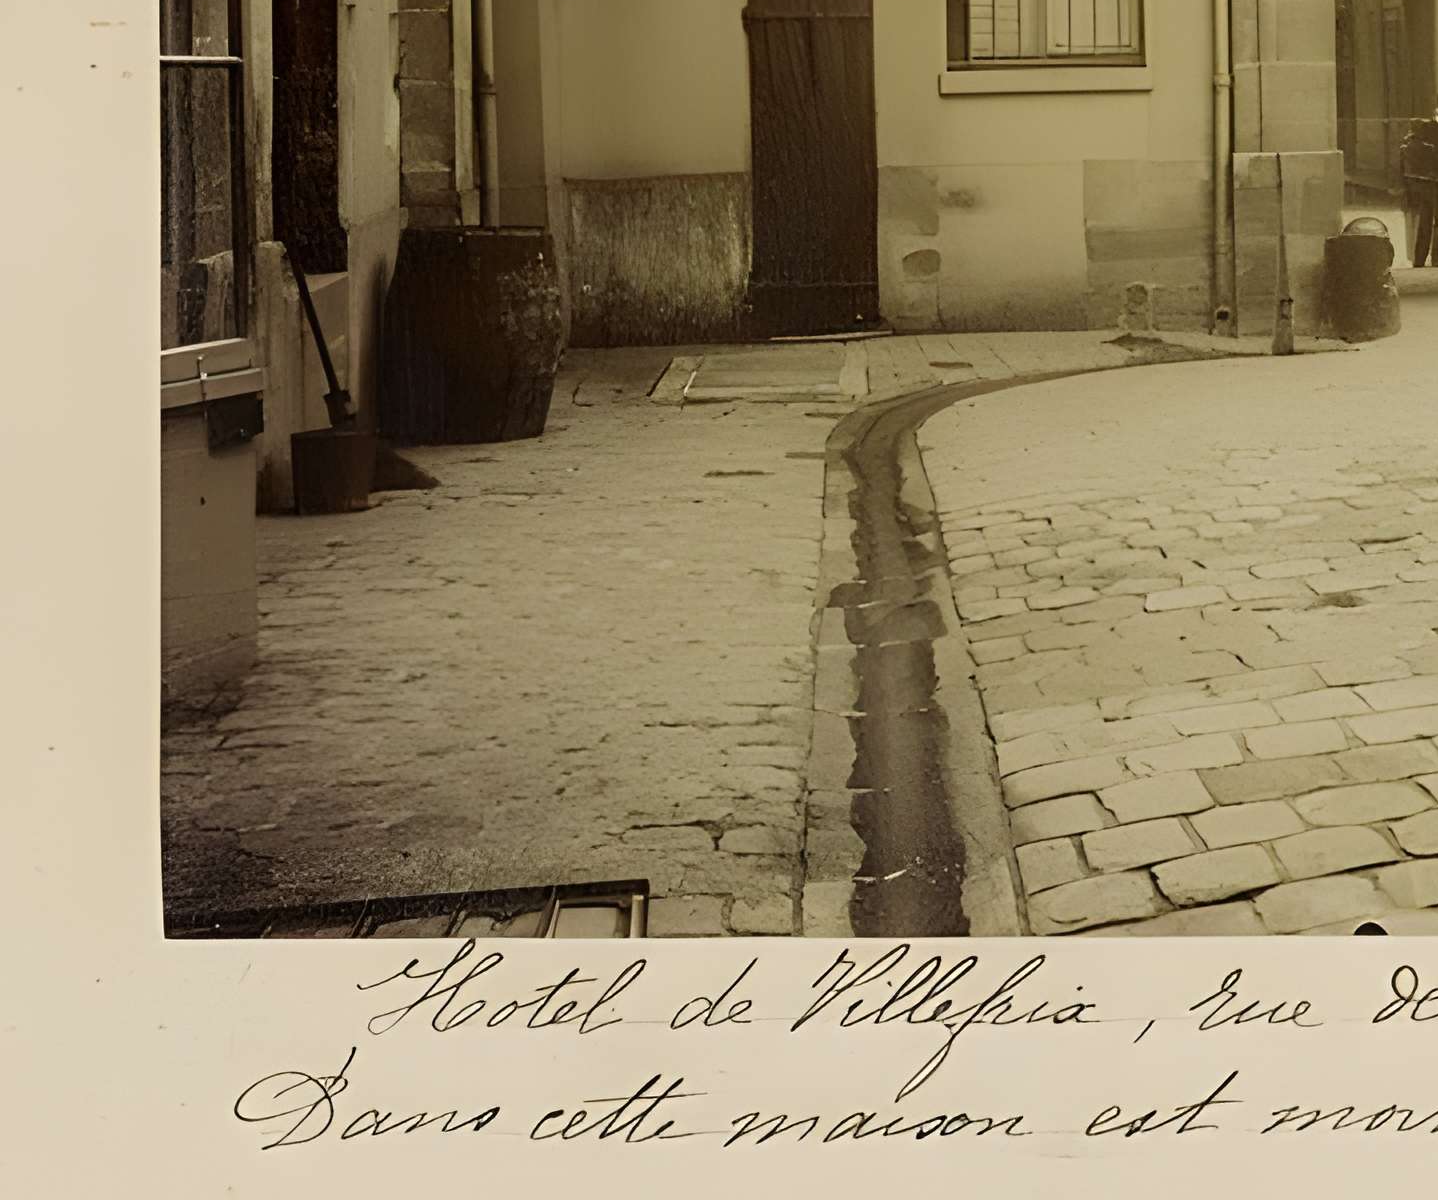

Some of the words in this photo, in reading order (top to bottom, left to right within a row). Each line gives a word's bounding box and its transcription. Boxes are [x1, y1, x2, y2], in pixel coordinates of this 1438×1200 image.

[670, 957, 754, 1030] de
[1189, 968, 1324, 1031] rue
[234, 1046, 501, 1150] Dans
[530, 1073, 709, 1144] cette
[722, 1110, 1033, 1148] maison
[1085, 1070, 1244, 1138] est
